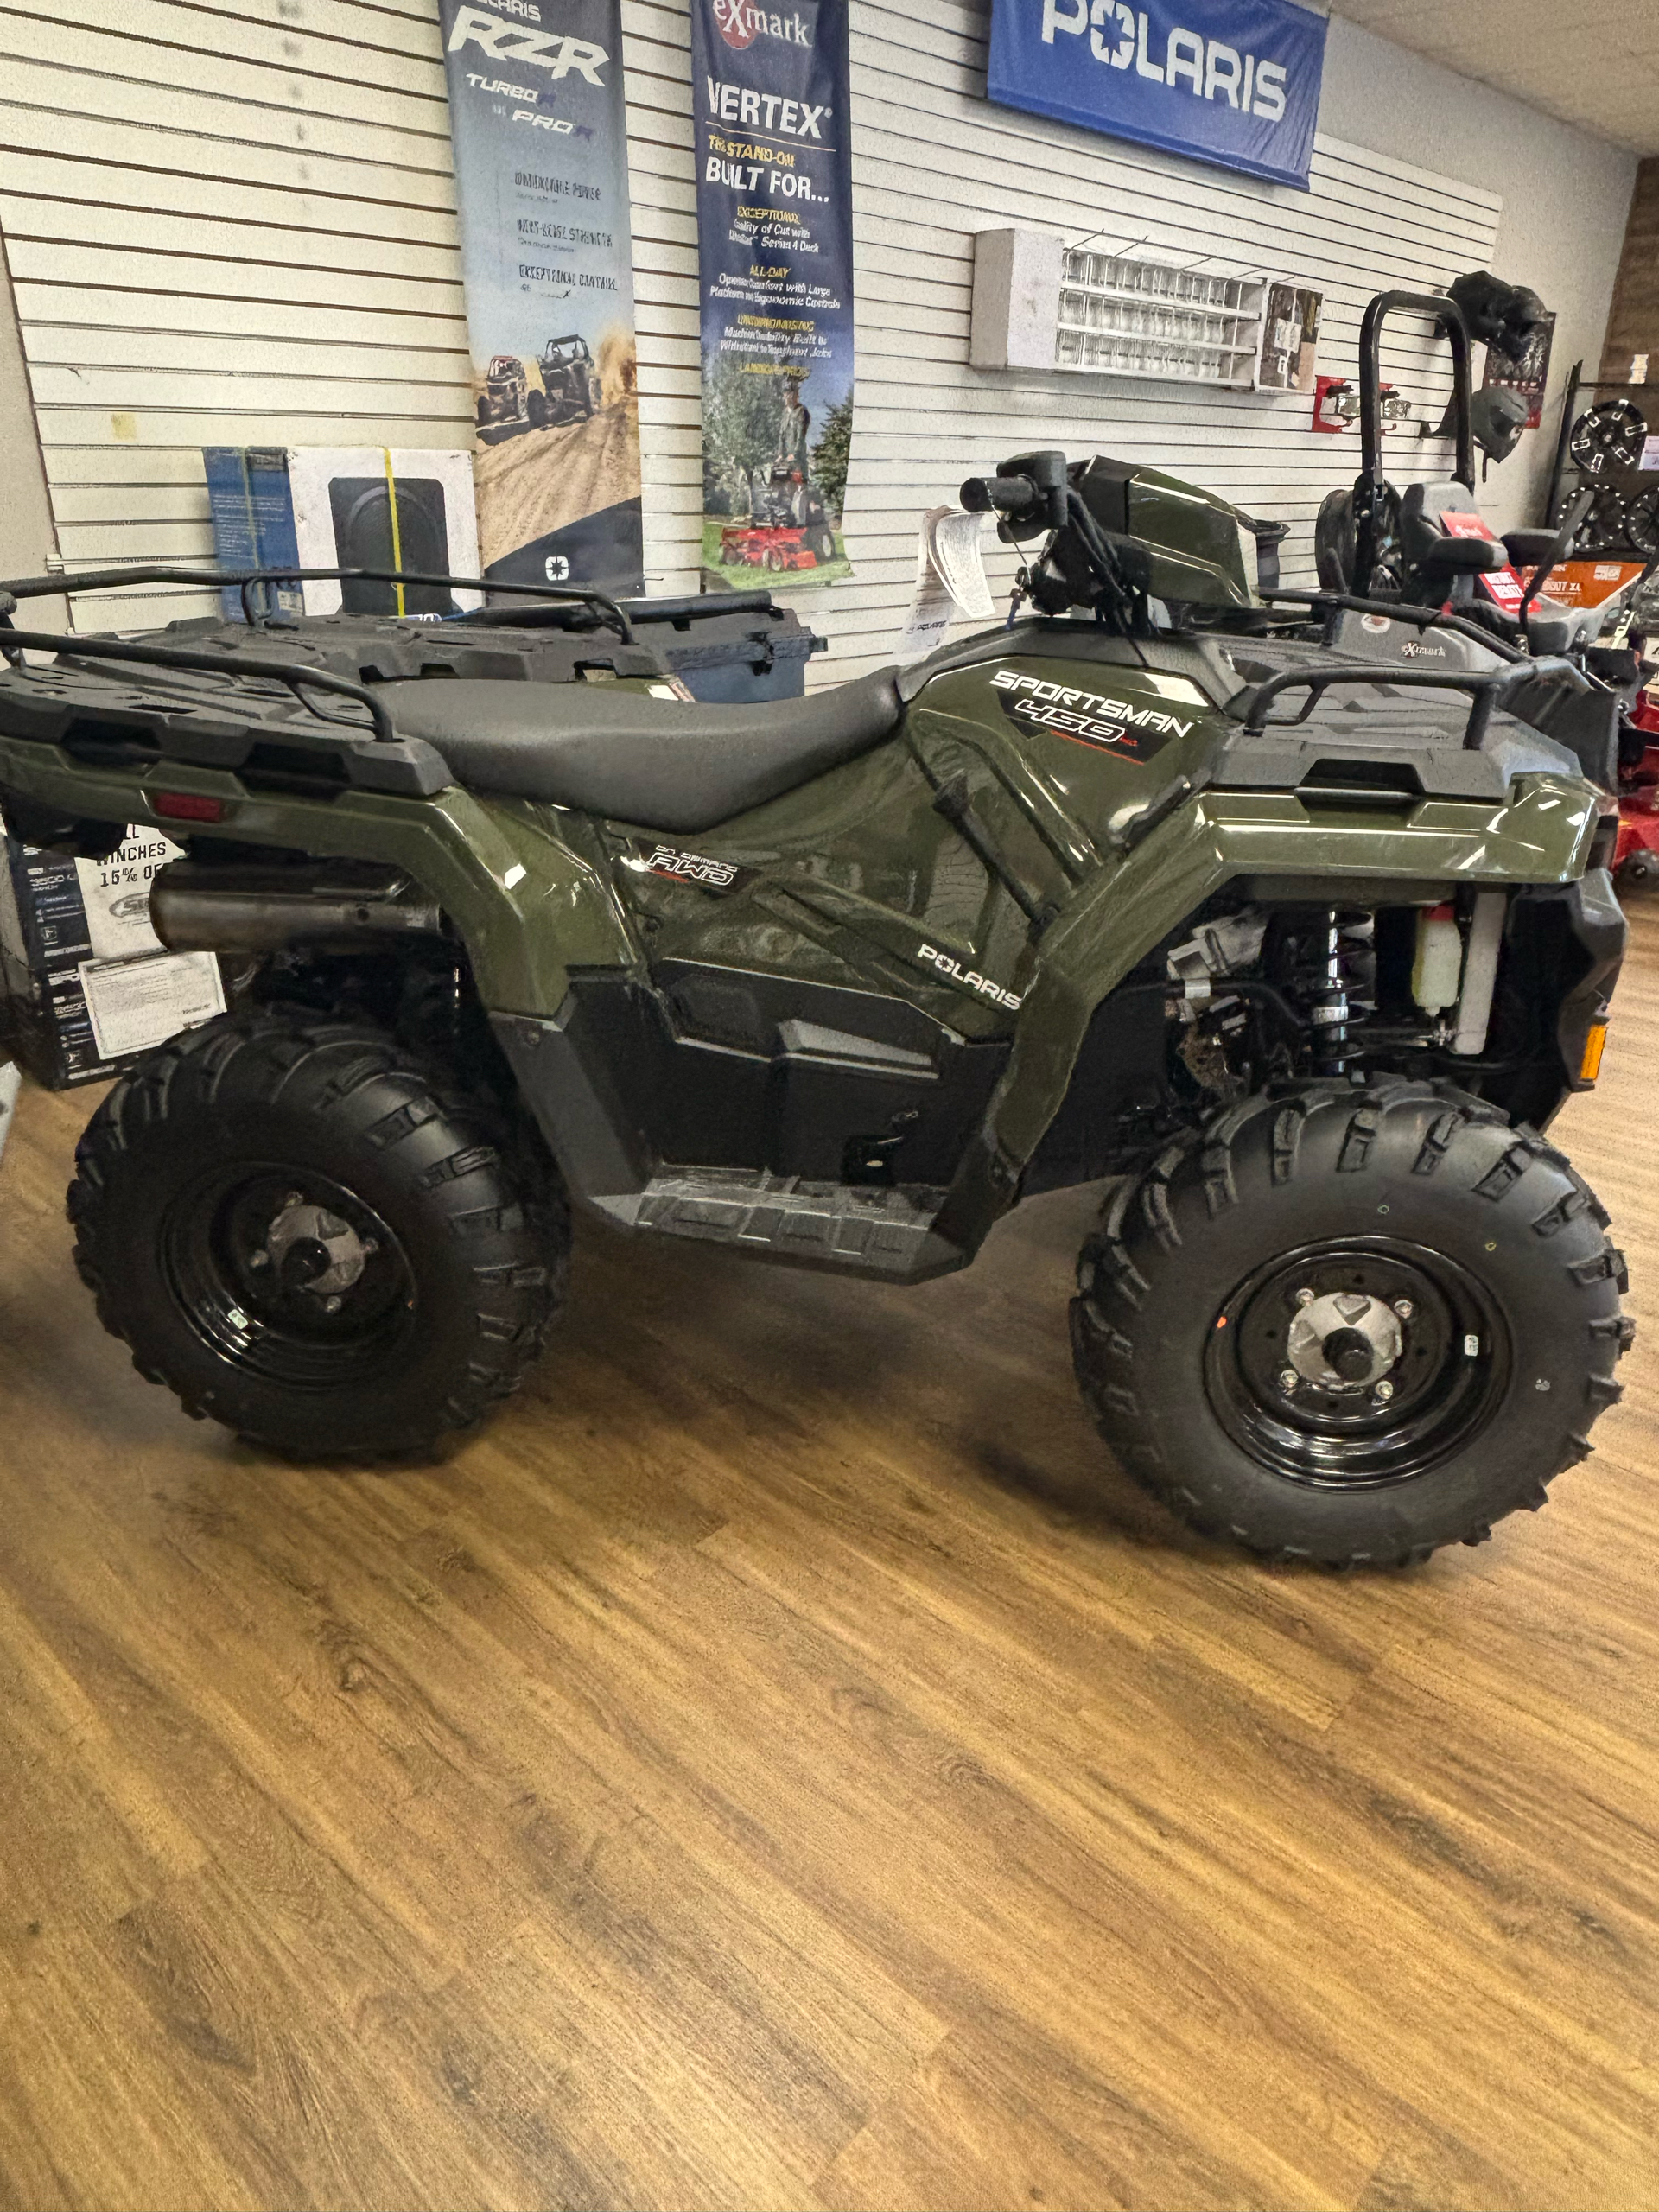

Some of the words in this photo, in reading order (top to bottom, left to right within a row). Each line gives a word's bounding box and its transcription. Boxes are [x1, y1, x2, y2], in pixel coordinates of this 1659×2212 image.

[448, 5, 610, 87] RZR
[1041, 0, 1287, 122] POLARIS
[466, 73, 539, 104] TURBO
[512, 109, 575, 135] PRO
[706, 156, 764, 191] BUILT
[989, 670, 1194, 738] SPORTSMAN
[1014, 698, 1126, 743] 450
[96, 842, 167, 867] INCHES
[647, 851, 734, 886] AWD
[917, 944, 1023, 1011] POLARIS
